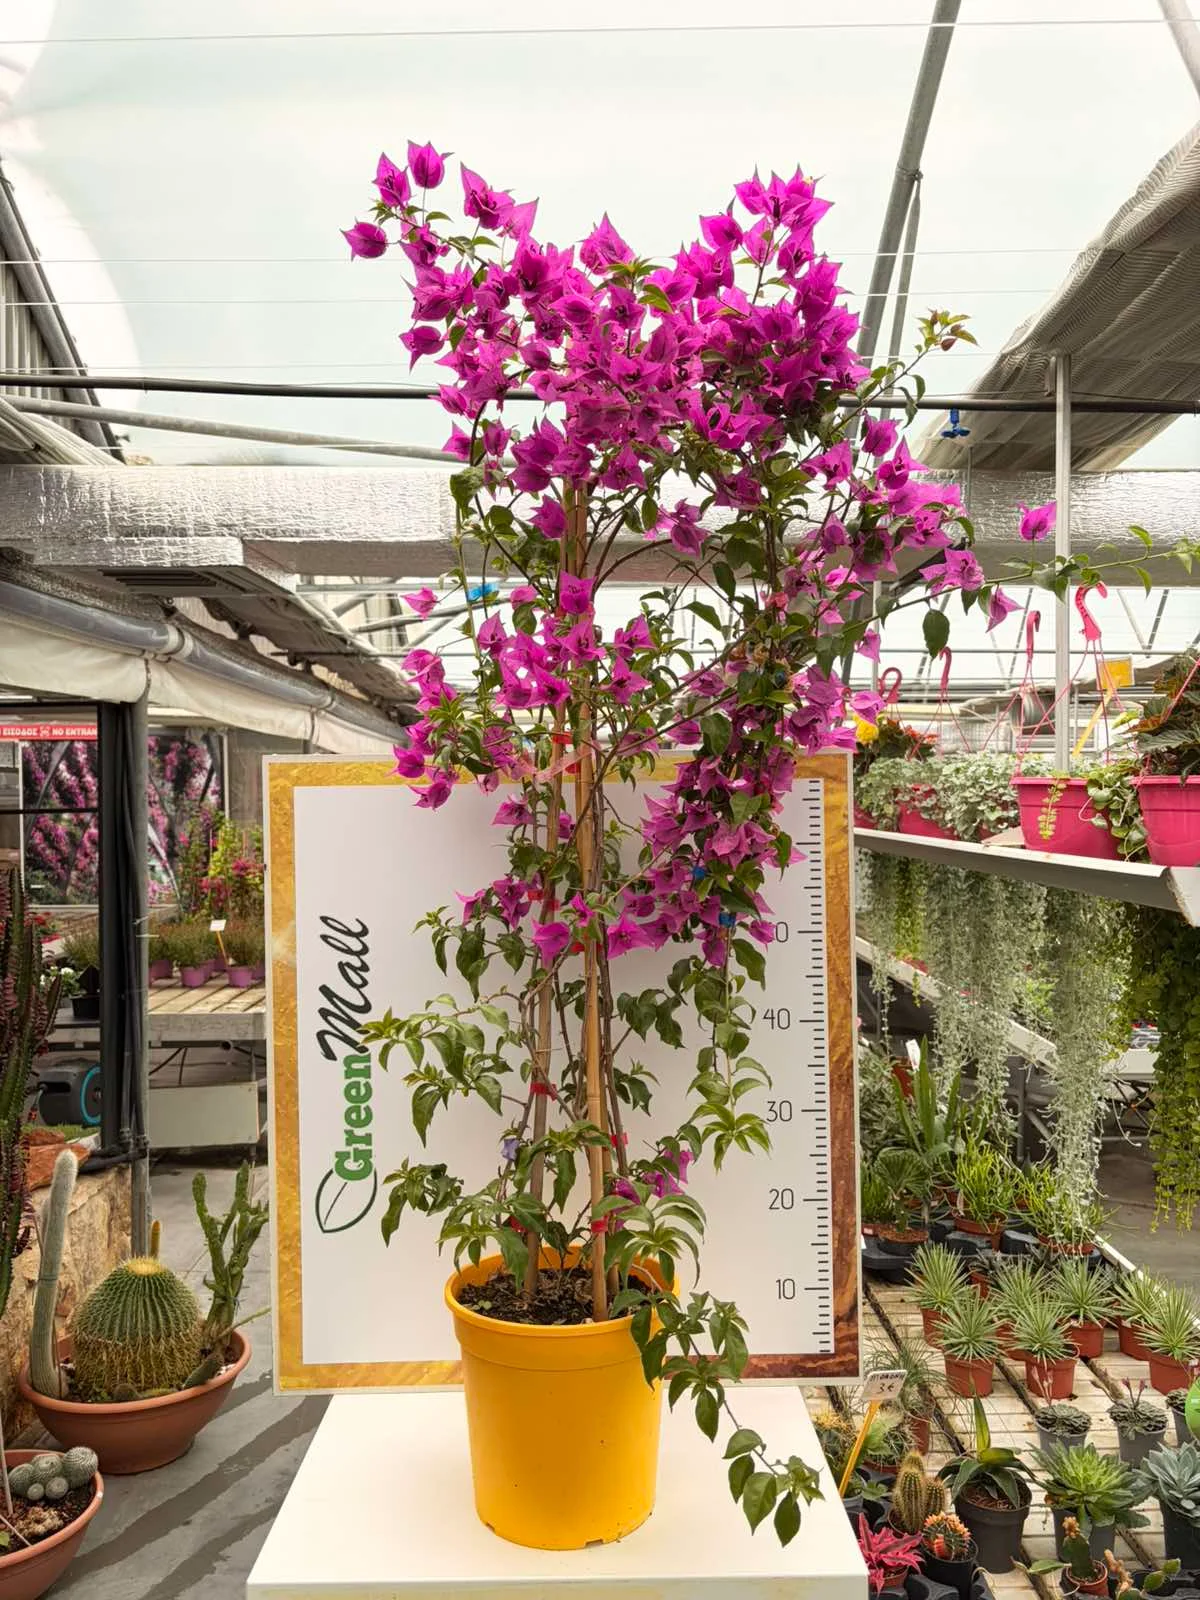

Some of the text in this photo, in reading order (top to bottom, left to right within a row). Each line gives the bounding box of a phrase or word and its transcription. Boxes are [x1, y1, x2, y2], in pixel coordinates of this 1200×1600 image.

[52, 727, 64, 737] NO
[775, 921, 789, 943] 0
[763, 1008, 791, 1030] 40
[766, 1100, 793, 1122] 30
[769, 1188, 795, 1210] 20
[776, 1278, 796, 1300] 10
